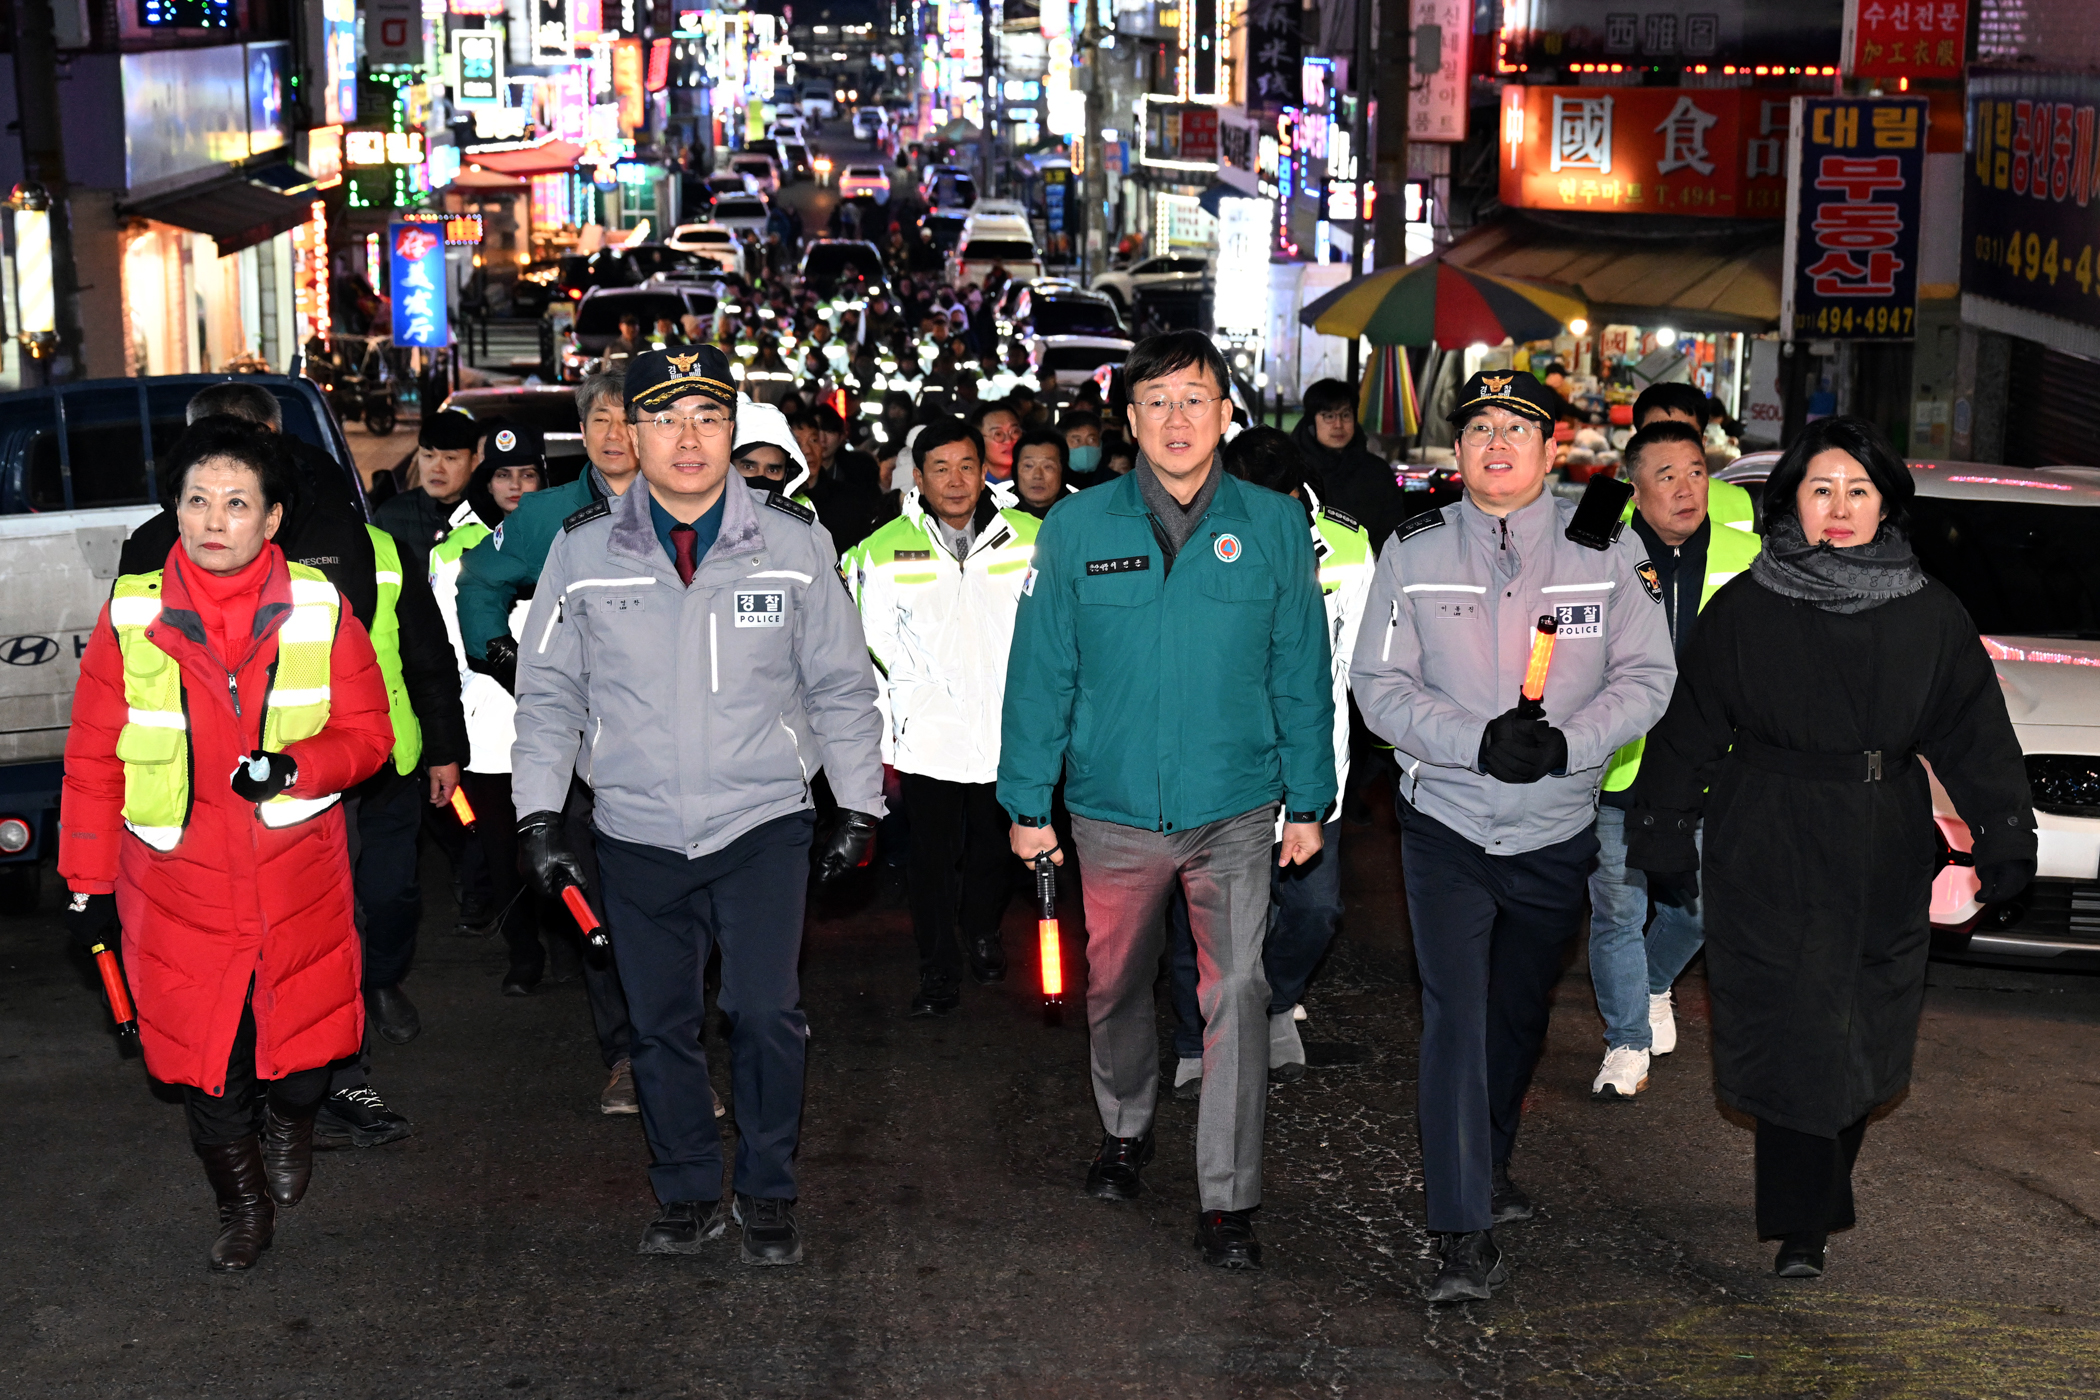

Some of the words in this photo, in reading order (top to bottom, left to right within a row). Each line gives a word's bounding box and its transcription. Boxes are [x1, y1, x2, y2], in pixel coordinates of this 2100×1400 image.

[1863, 2, 1960, 31] 수선전문
[1860, 38, 1956, 66] 加工衣服
[1812, 106, 1919, 149] 대림
[1805, 154, 1905, 297] 부동산
[740, 615, 780, 623] POLICE
[1559, 626, 1598, 635] POLICE
